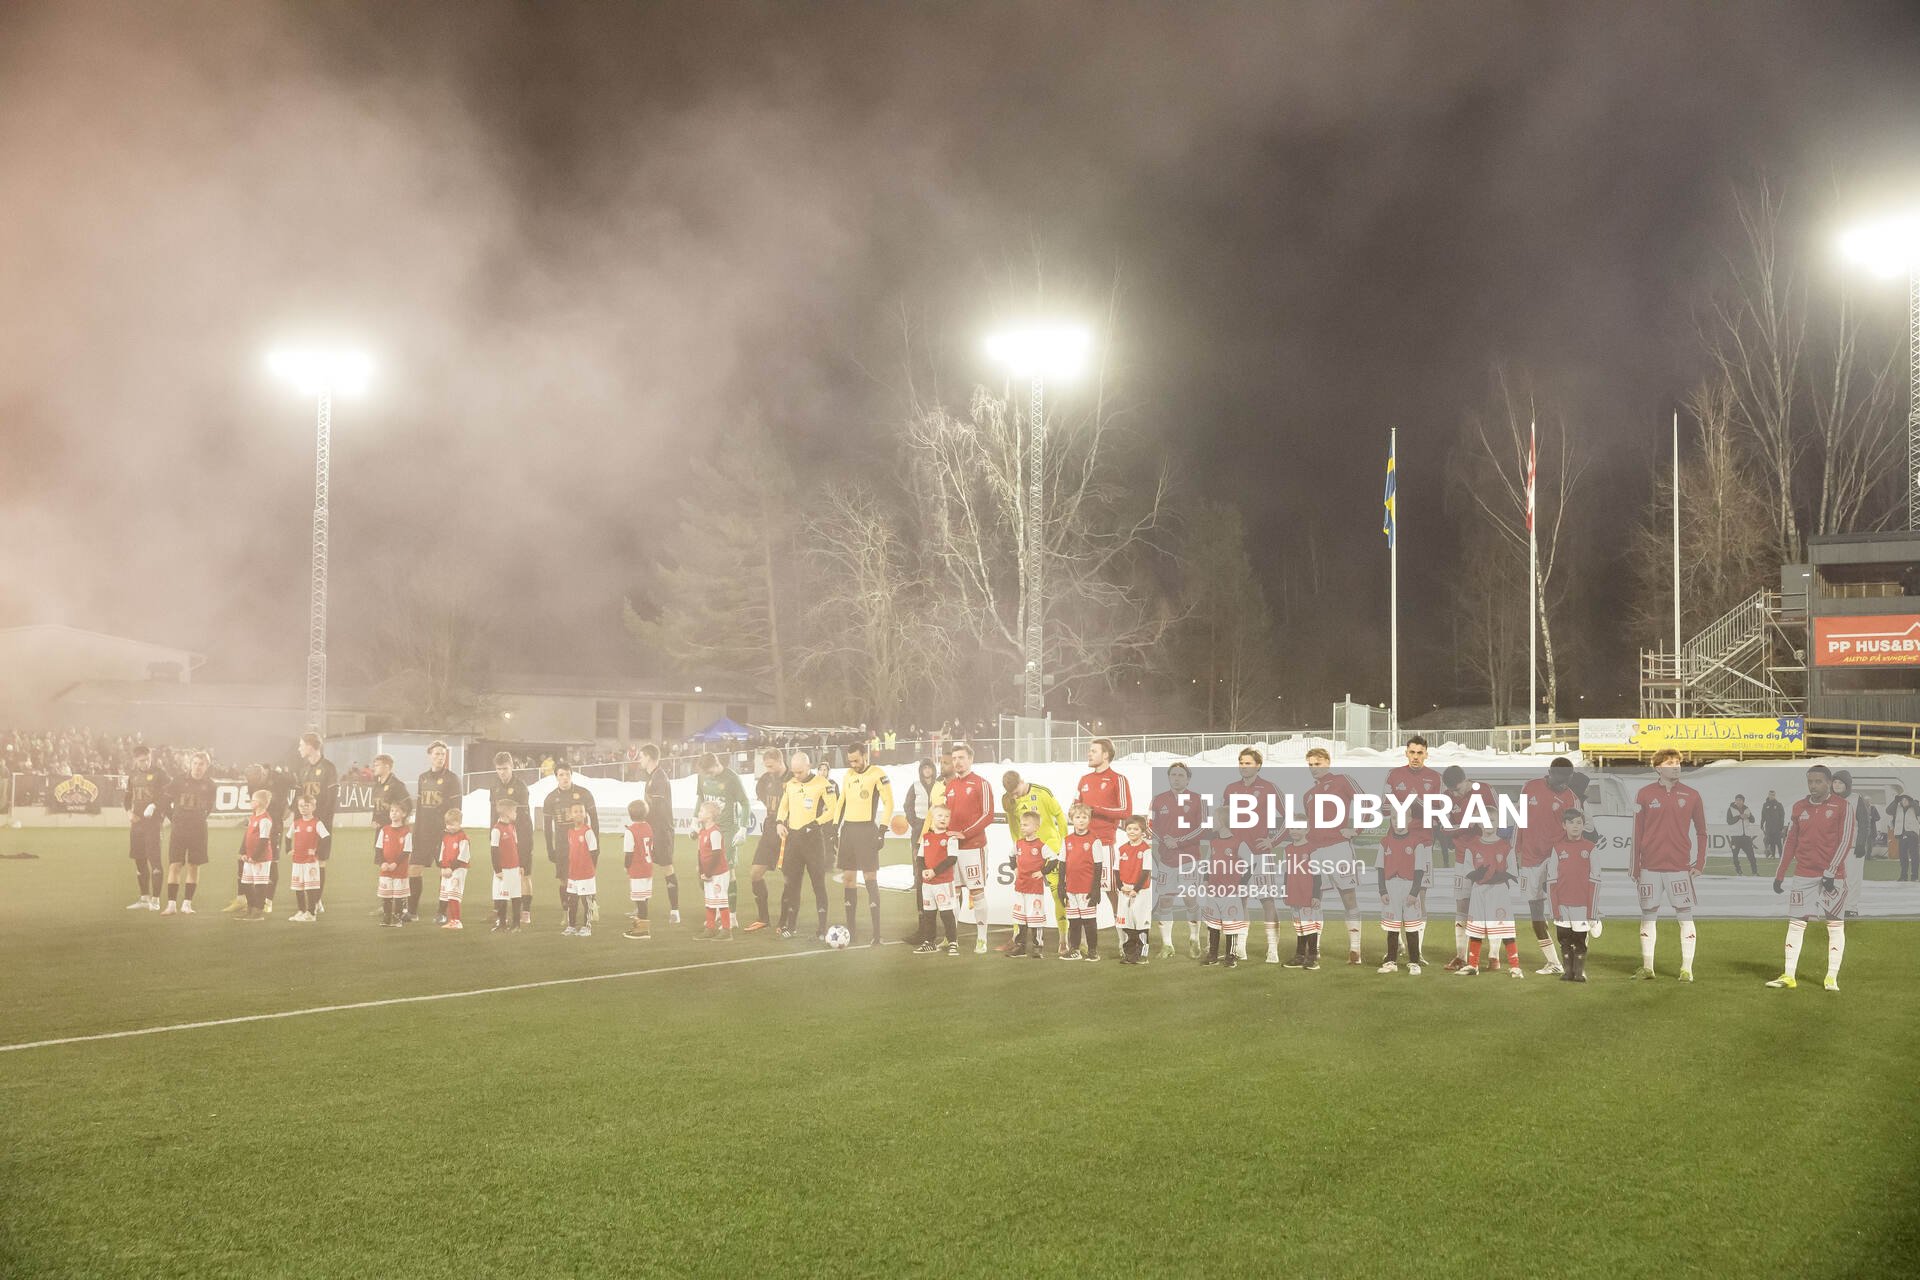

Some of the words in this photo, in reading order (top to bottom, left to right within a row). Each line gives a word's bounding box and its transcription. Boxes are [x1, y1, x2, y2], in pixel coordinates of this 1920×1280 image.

[1828, 640, 1851, 653] PP
[1743, 732, 1764, 740] nära
[1765, 732, 1780, 741] dig
